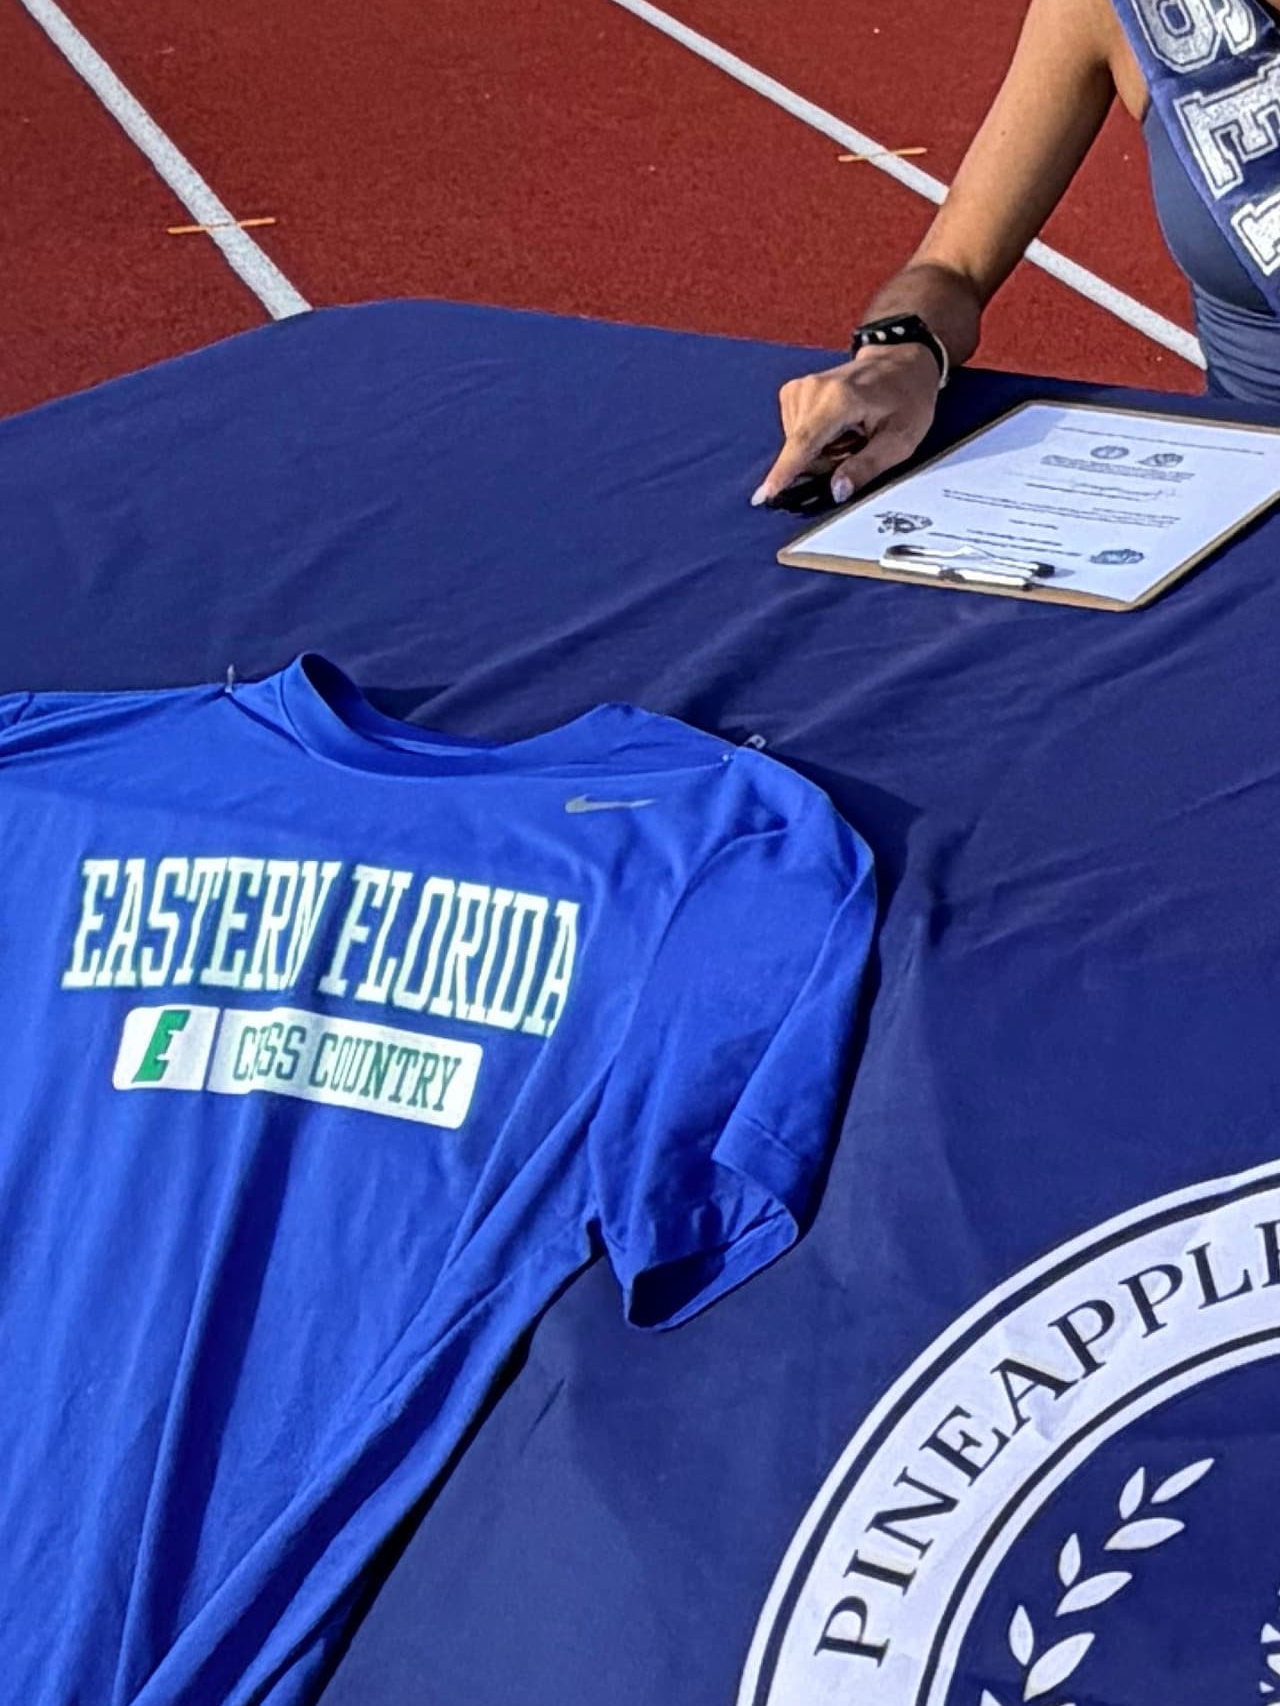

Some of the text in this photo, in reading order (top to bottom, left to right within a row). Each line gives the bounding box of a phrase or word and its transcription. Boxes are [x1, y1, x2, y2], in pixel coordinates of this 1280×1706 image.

[61, 856, 579, 1038] EASTERN FLORIDA
[132, 1009, 190, 1083] E
[309, 1032, 461, 1111] COUNTRY
